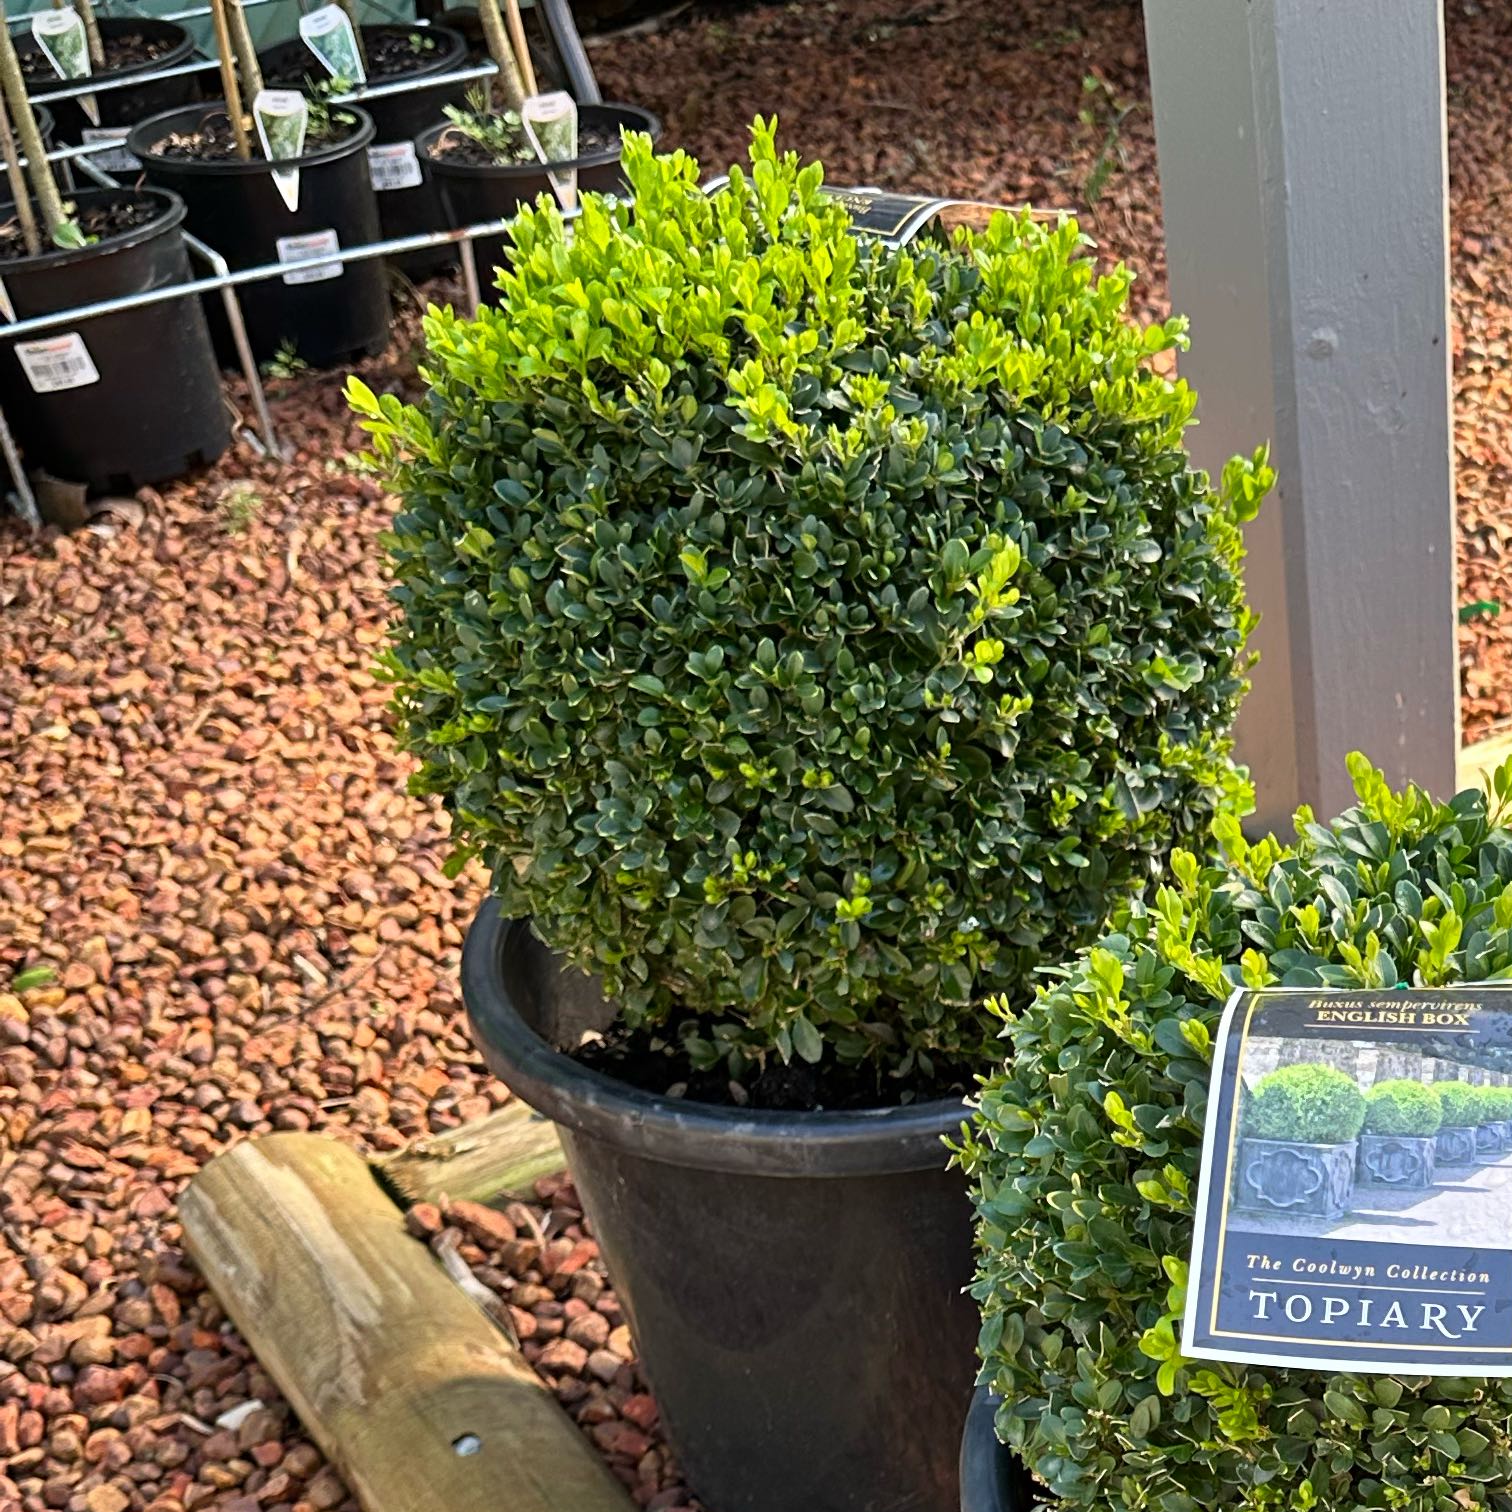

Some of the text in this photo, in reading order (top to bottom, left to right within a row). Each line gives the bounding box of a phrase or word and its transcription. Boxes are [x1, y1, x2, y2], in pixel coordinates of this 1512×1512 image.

[1308, 999, 1484, 1014] Buxus sempervirens
[1316, 1010, 1470, 1026] ENGLISH BOX
[1246, 1254, 1491, 1284] The Coolwyn Collection
[1248, 1289, 1486, 1339] TOPIARY
